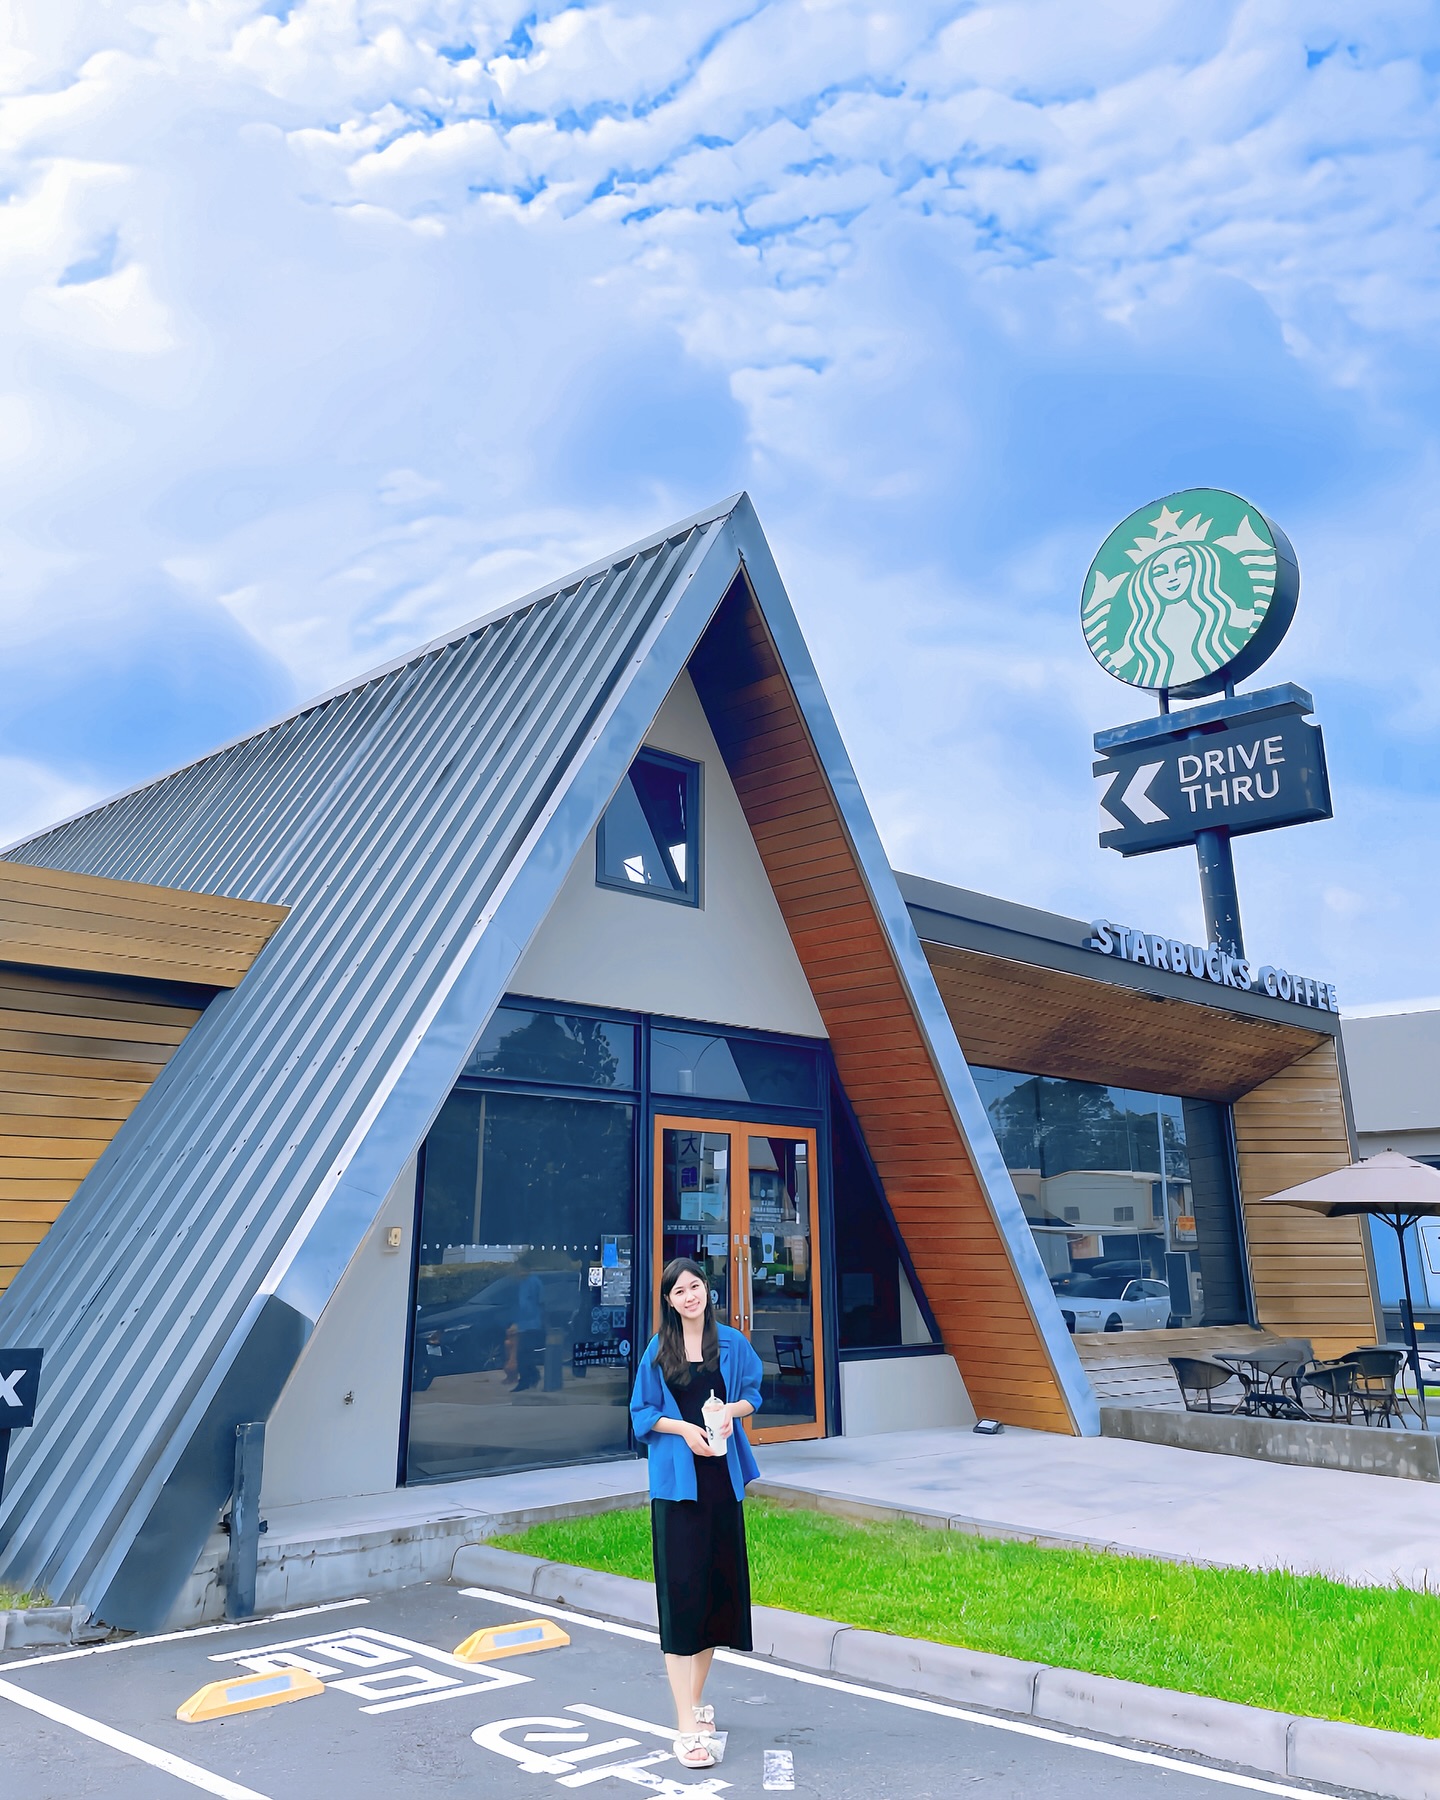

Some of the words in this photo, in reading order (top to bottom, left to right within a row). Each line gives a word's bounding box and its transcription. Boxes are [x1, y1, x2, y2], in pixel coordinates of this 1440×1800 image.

[1178, 735, 1285, 783] DRIVE
[1181, 769, 1279, 812] THRU
[1090, 919, 1251, 990] STARBUCKS
[1258, 965, 1339, 1012] COFFEE
